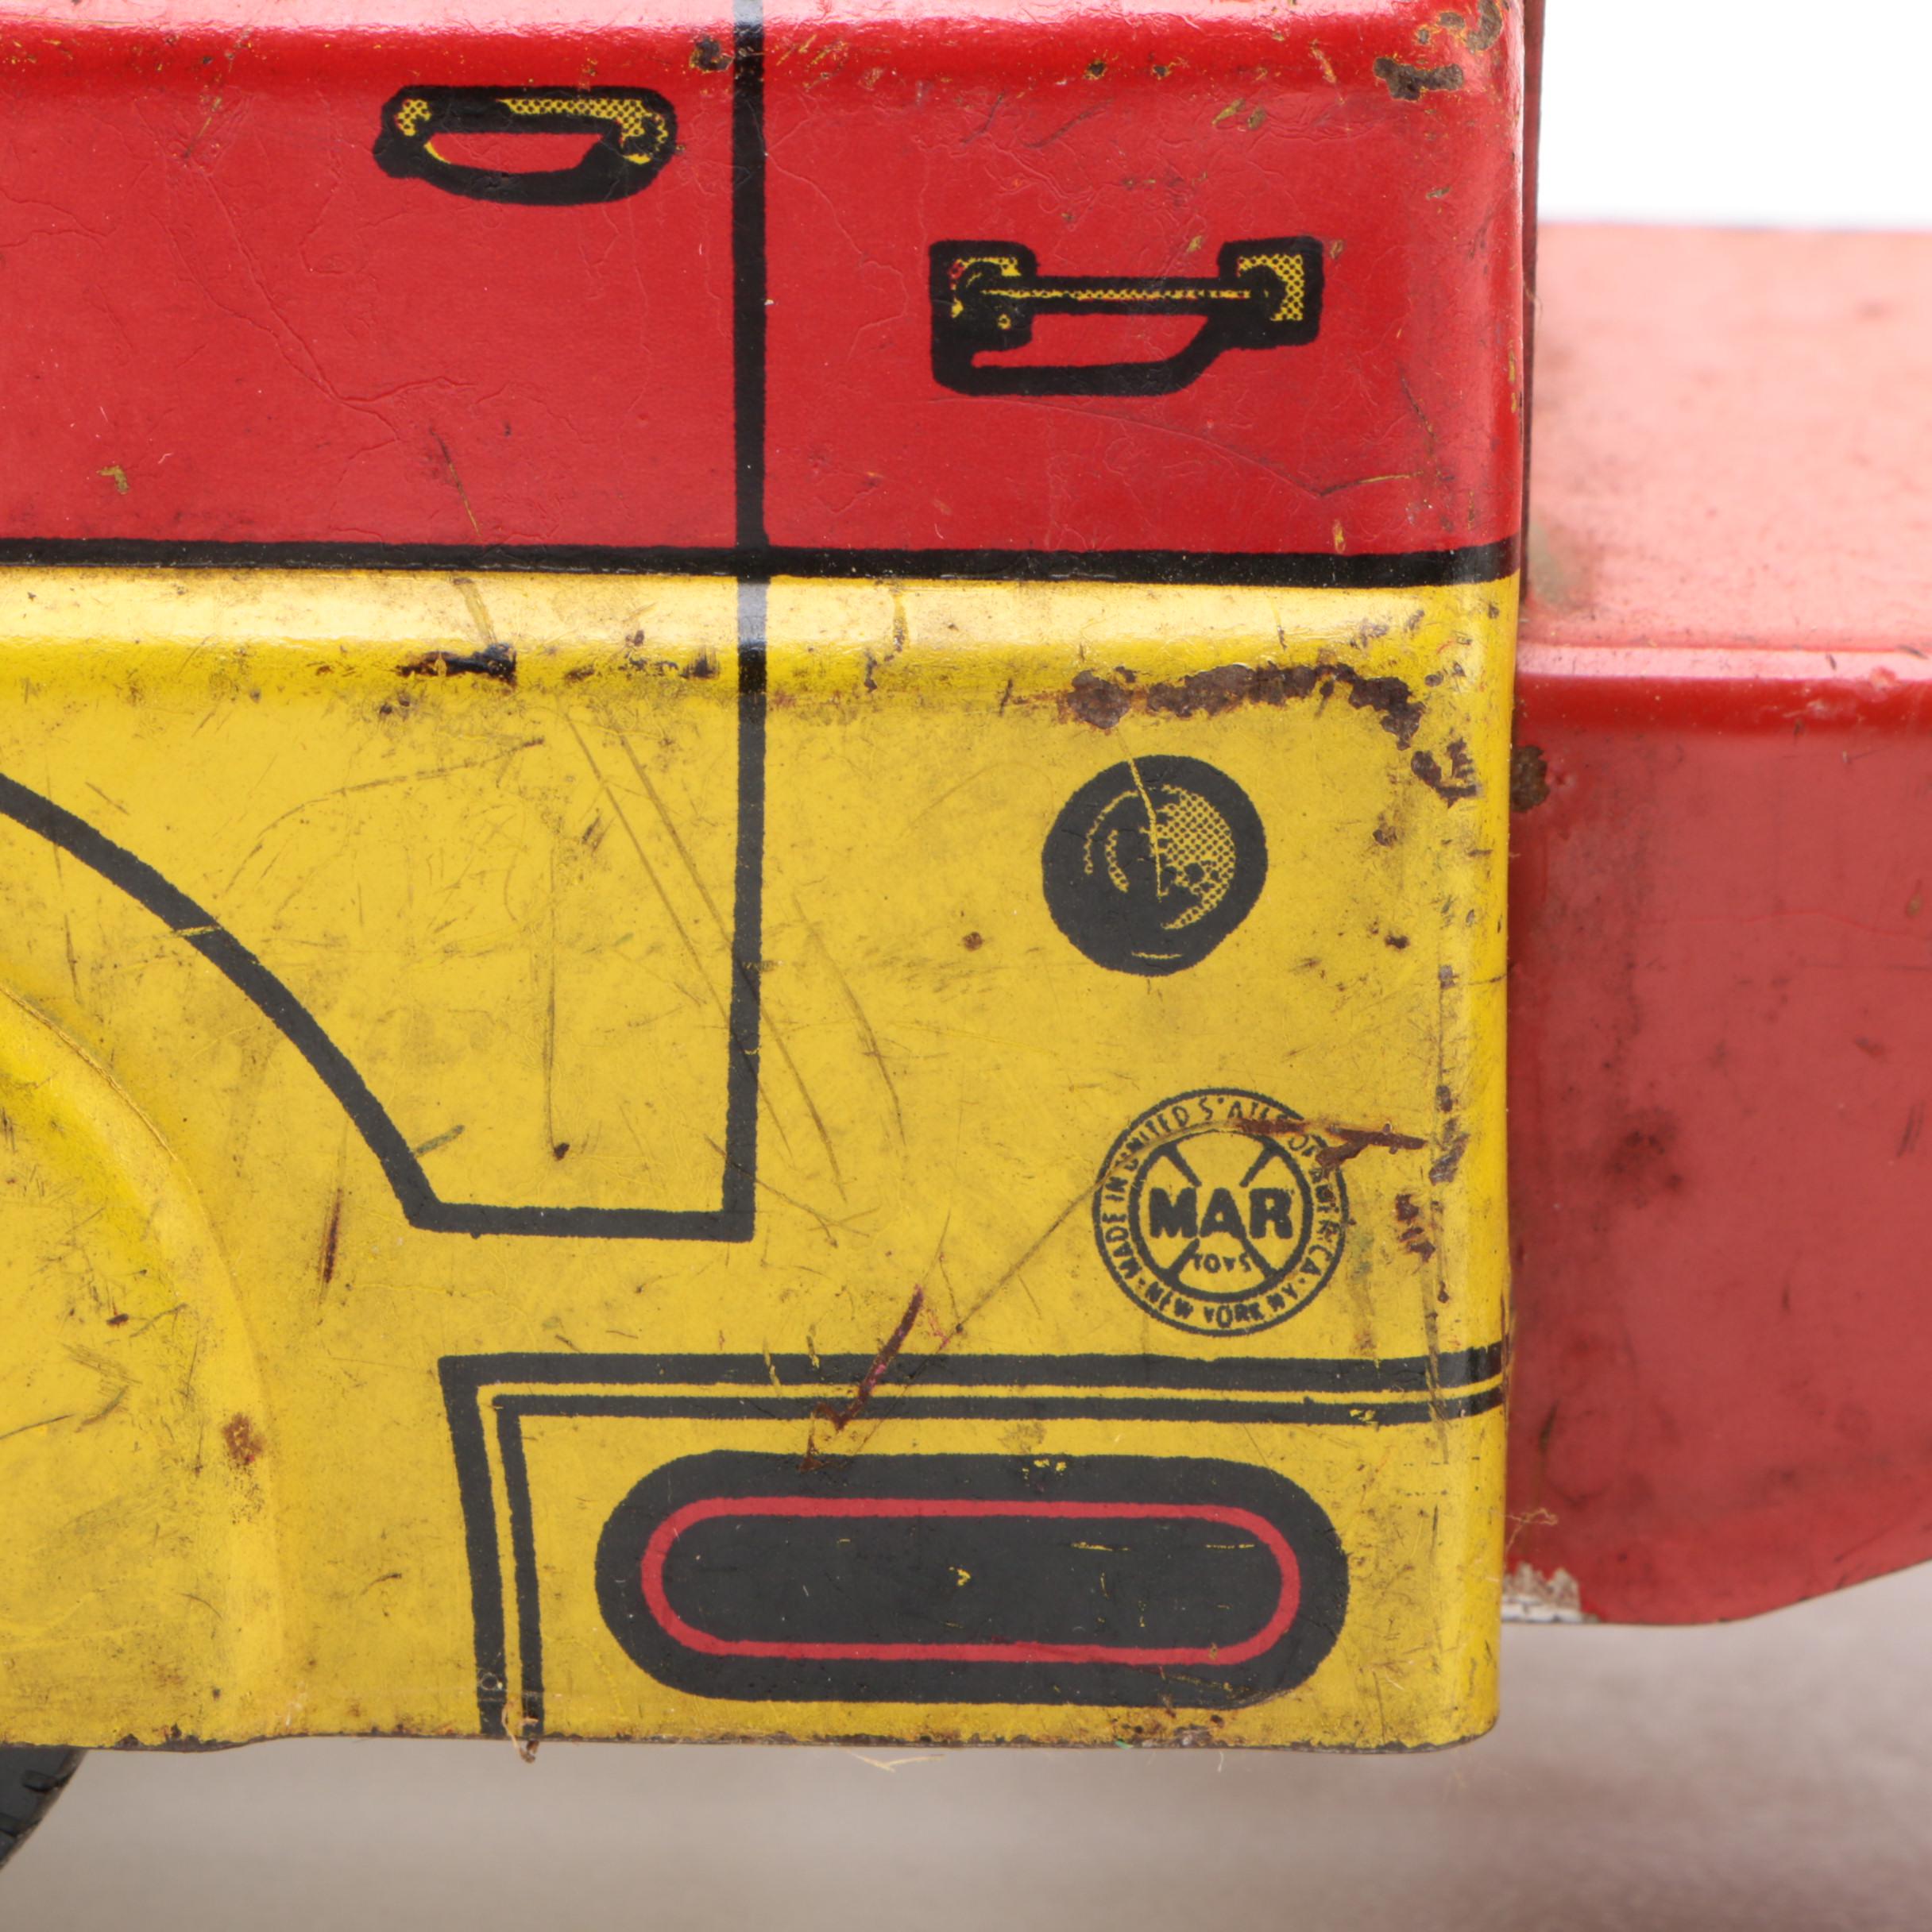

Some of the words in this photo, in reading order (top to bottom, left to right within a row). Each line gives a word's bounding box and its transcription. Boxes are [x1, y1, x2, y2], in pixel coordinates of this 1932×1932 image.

[1104, 1177, 1129, 1202] IN
[1149, 1186, 1294, 1239] MAR
[1102, 1213, 1142, 1280] MADE
[1193, 1253, 1252, 1273] TOYS
[1144, 1281, 1194, 1320] NEW
[1204, 1303, 1265, 1328] YORK
